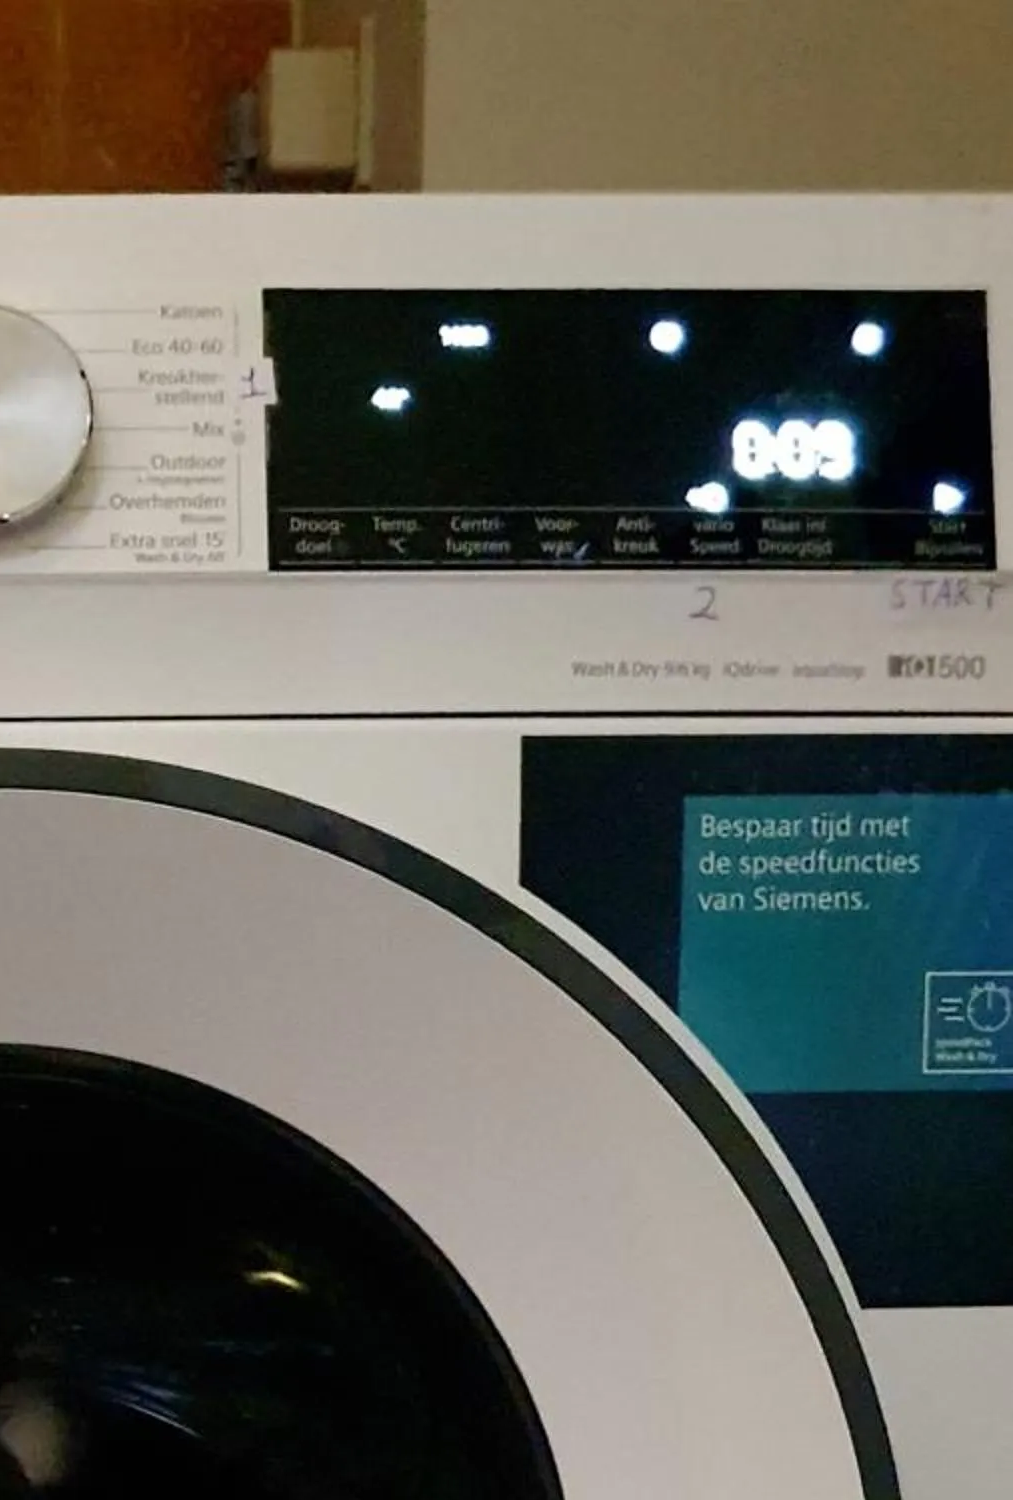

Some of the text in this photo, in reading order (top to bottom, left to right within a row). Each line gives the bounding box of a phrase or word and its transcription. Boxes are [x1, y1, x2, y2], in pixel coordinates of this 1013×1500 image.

[132, 339, 164, 356] Eco
[154, 390, 225, 407] stellend
[192, 421, 225, 438] Mix
[150, 454, 226, 471] Outdoor
[109, 493, 226, 512] Overhemden
[290, 516, 346, 535] Droog-
[535, 516, 579, 533] Voor-
[761, 517, 800, 532] Klaar
[109, 533, 155, 550] Extra
[160, 531, 198, 549] snel
[295, 539, 332, 555] doel
[446, 538, 510, 557] fugeren
[613, 537, 659, 555] kreuk
[689, 537, 739, 556] Speed
[757, 537, 834, 558] Droogtijd
[688, 586, 720, 621] 2
[890, 579, 1004, 612] START
[700, 812, 911, 844] Bespaar tijd met
[698, 848, 921, 879] de speedfuncties
[698, 886, 870, 912] van Siemens.
